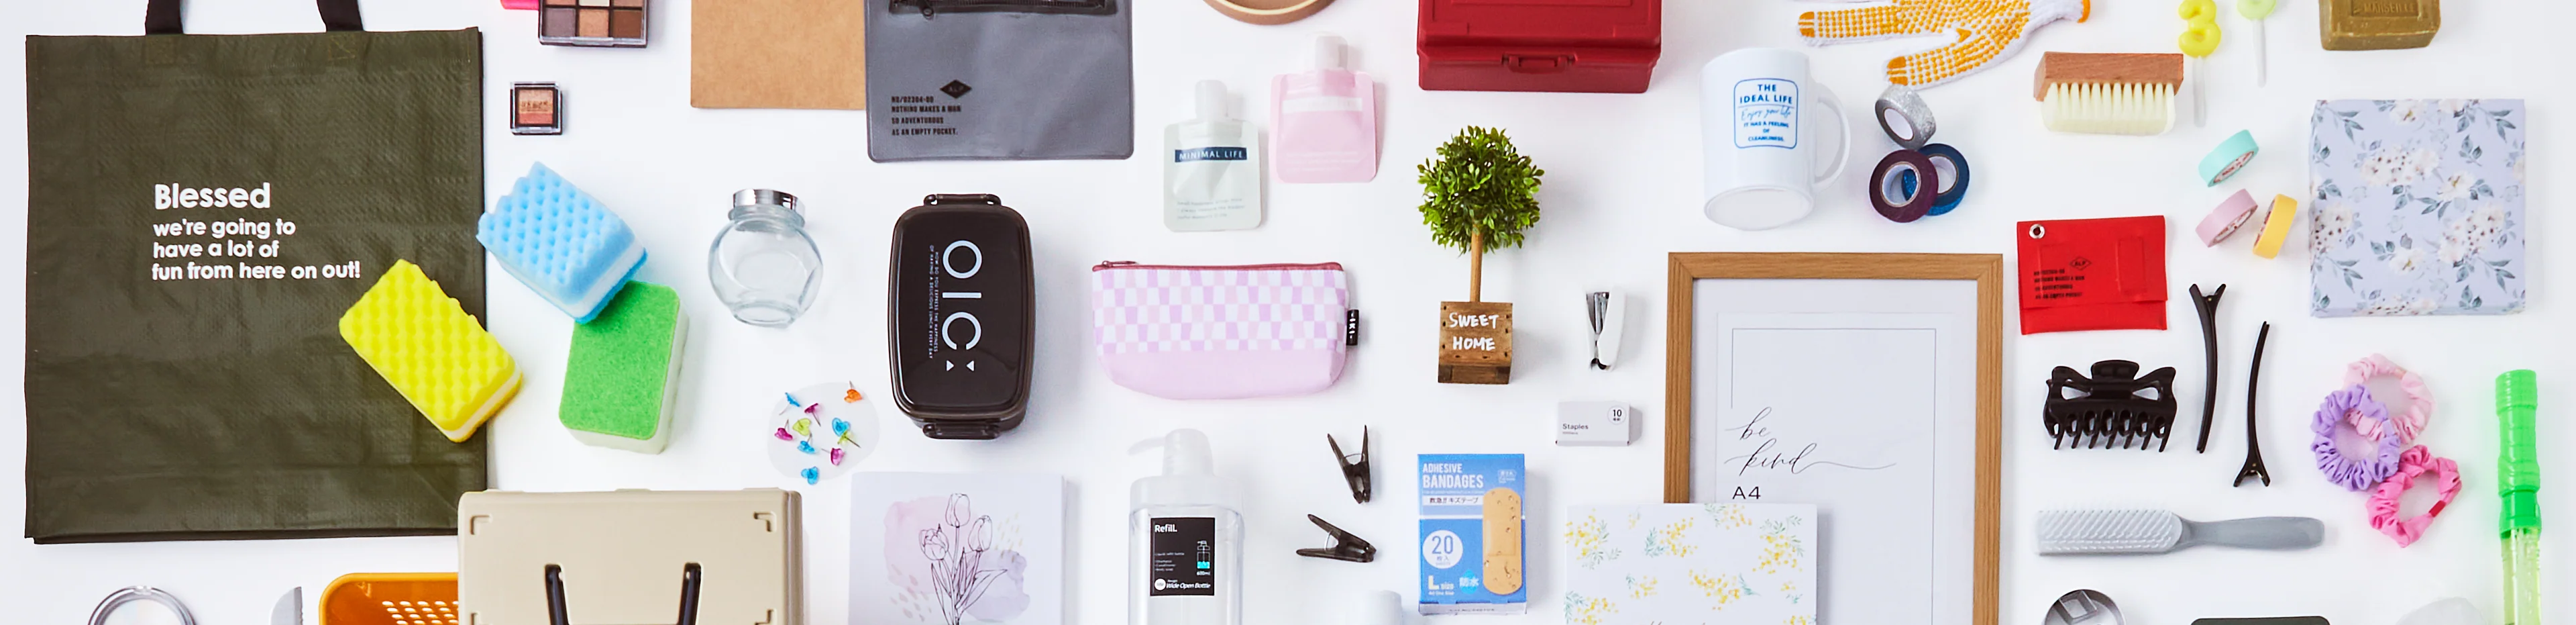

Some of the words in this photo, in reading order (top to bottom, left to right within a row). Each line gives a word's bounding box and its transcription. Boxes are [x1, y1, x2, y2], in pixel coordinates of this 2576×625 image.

[1758, 84, 1776, 92] THE
[1739, 94, 1770, 104] IDEAL
[1774, 94, 1792, 104] LIFE
[1179, 150, 1220, 160] MINIMAL
[1224, 150, 1242, 158] LIFE
[154, 182, 270, 209] Blessed
[153, 218, 207, 236] we're
[211, 218, 270, 239] going
[276, 218, 296, 235] to
[153, 242, 203, 258] have
[208, 242, 222, 256] a
[227, 240, 254, 257] lot
[258, 240, 280, 258] of
[152, 263, 182, 281] fun
[187, 262, 233, 279] from
[239, 262, 286, 279] here
[290, 266, 317, 279] on
[322, 260, 360, 279] out!
[1449, 312, 1499, 329] SWEET
[1452, 336, 1496, 351] HOME
[1613, 409, 1622, 417] 10
[1725, 407, 1772, 440] be
[1423, 463, 1462, 473] ADHESIVE
[1423, 474, 1484, 489] BANDAGES
[1732, 486, 1761, 499] A4
[1432, 535, 1454, 555] 20
[1428, 575, 1440, 590] L
